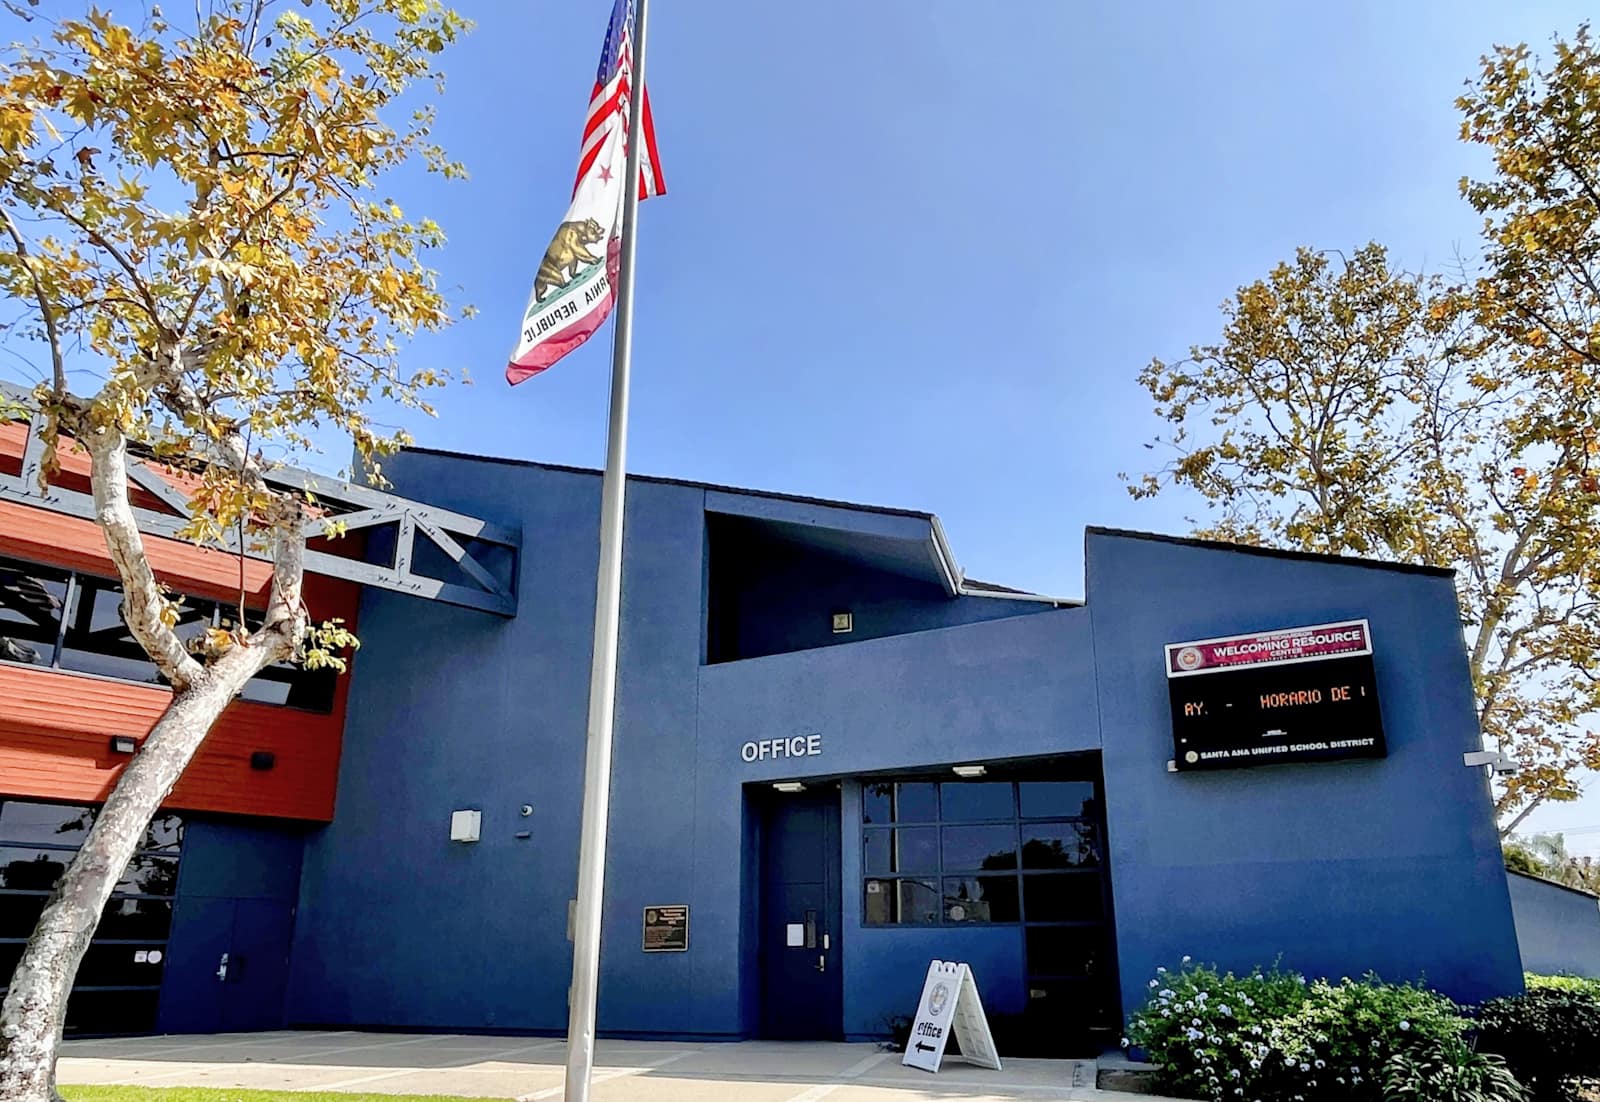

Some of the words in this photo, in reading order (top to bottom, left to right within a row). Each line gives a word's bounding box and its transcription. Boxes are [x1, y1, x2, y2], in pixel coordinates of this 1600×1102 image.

[1213, 639, 1290, 657] WELCOMING
[1292, 630, 1361, 648] RESOURCE
[1270, 647, 1303, 657] CENTER
[1259, 689, 1322, 709] HORARIO
[1330, 686, 1351, 701] DE
[741, 734, 822, 762] OFFICE
[1200, 750, 1230, 759] SANTA
[1231, 748, 1250, 757] ANA
[1251, 745, 1288, 755] UNIFIED
[1289, 742, 1328, 752] SCHOOL
[1330, 738, 1375, 748] DISTRICT
[917, 1022, 943, 1039] Office
